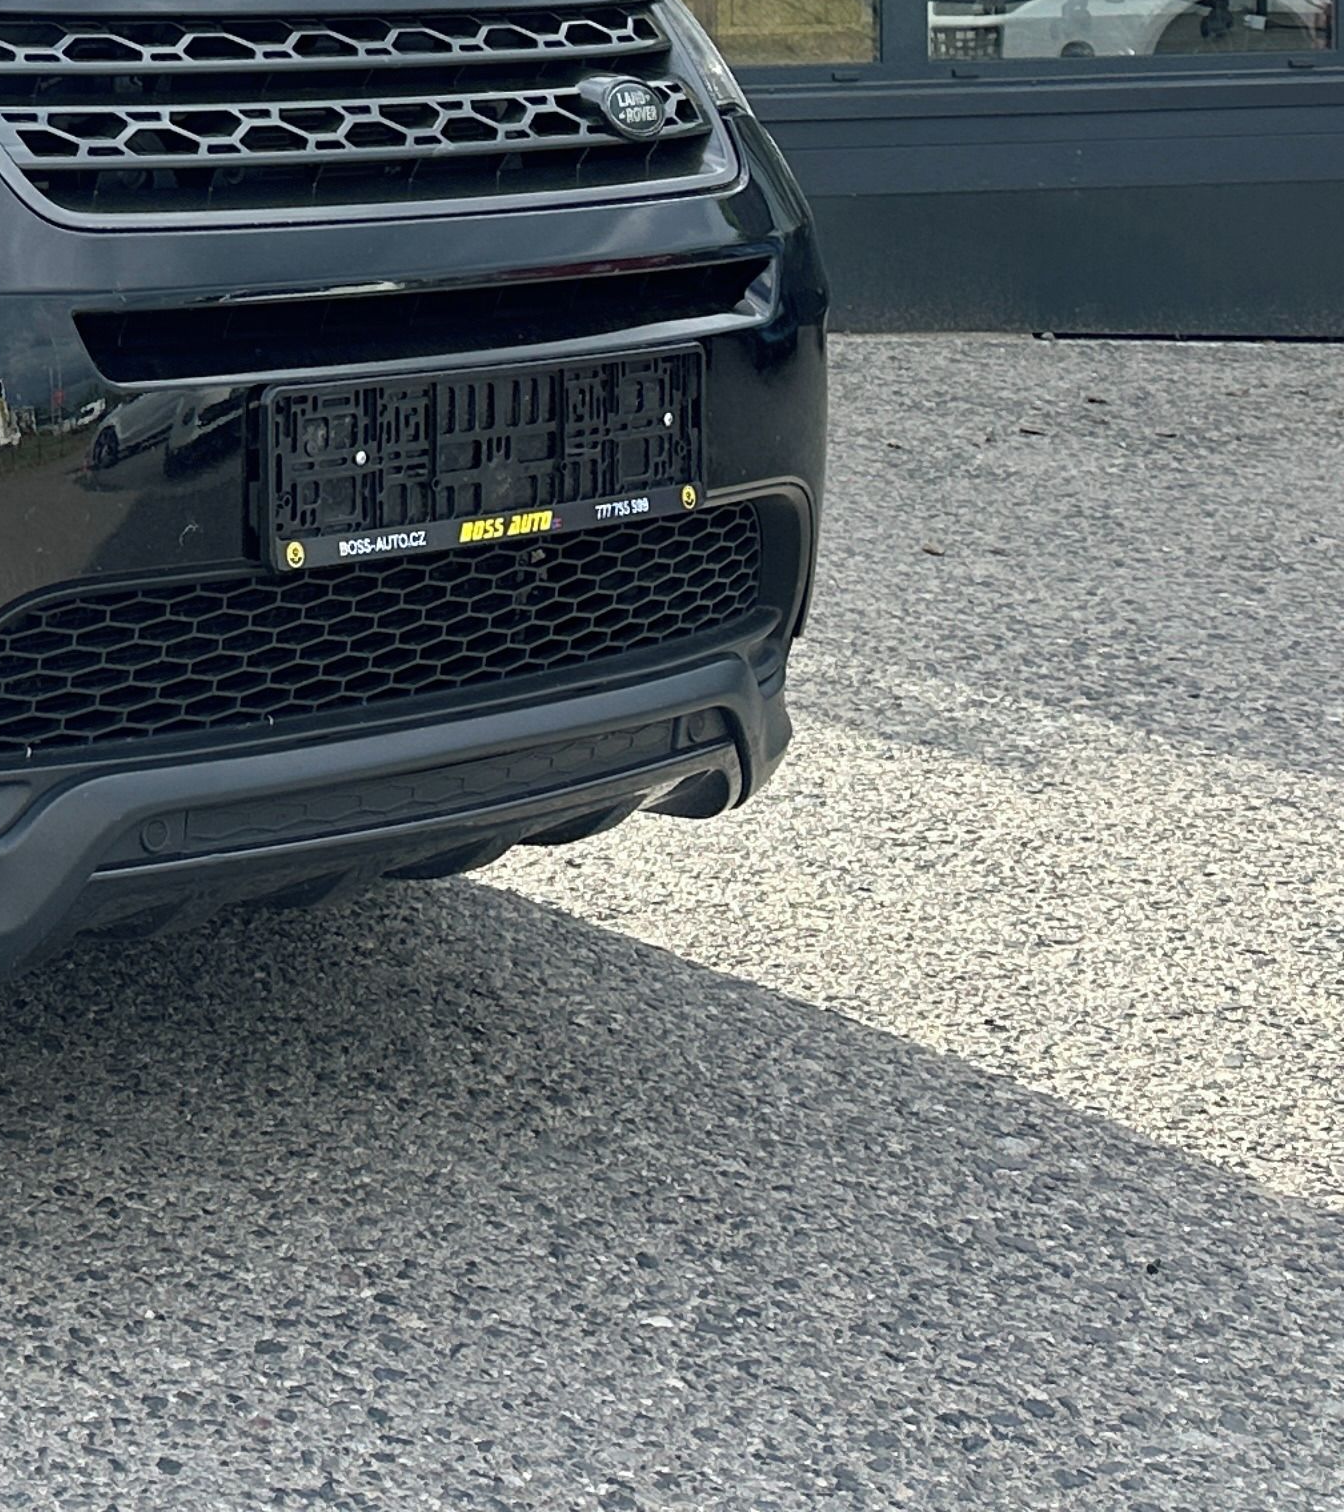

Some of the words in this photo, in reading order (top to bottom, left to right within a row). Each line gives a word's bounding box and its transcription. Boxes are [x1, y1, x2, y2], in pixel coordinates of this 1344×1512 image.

[626, 105, 657, 123] ROVER
[595, 504, 612, 520] 777
[612, 500, 630, 517] 755
[459, 519, 504, 543] BOSS
[507, 510, 553, 536] AUTO
[339, 531, 427, 556] BOSS-AUTO.CZ
